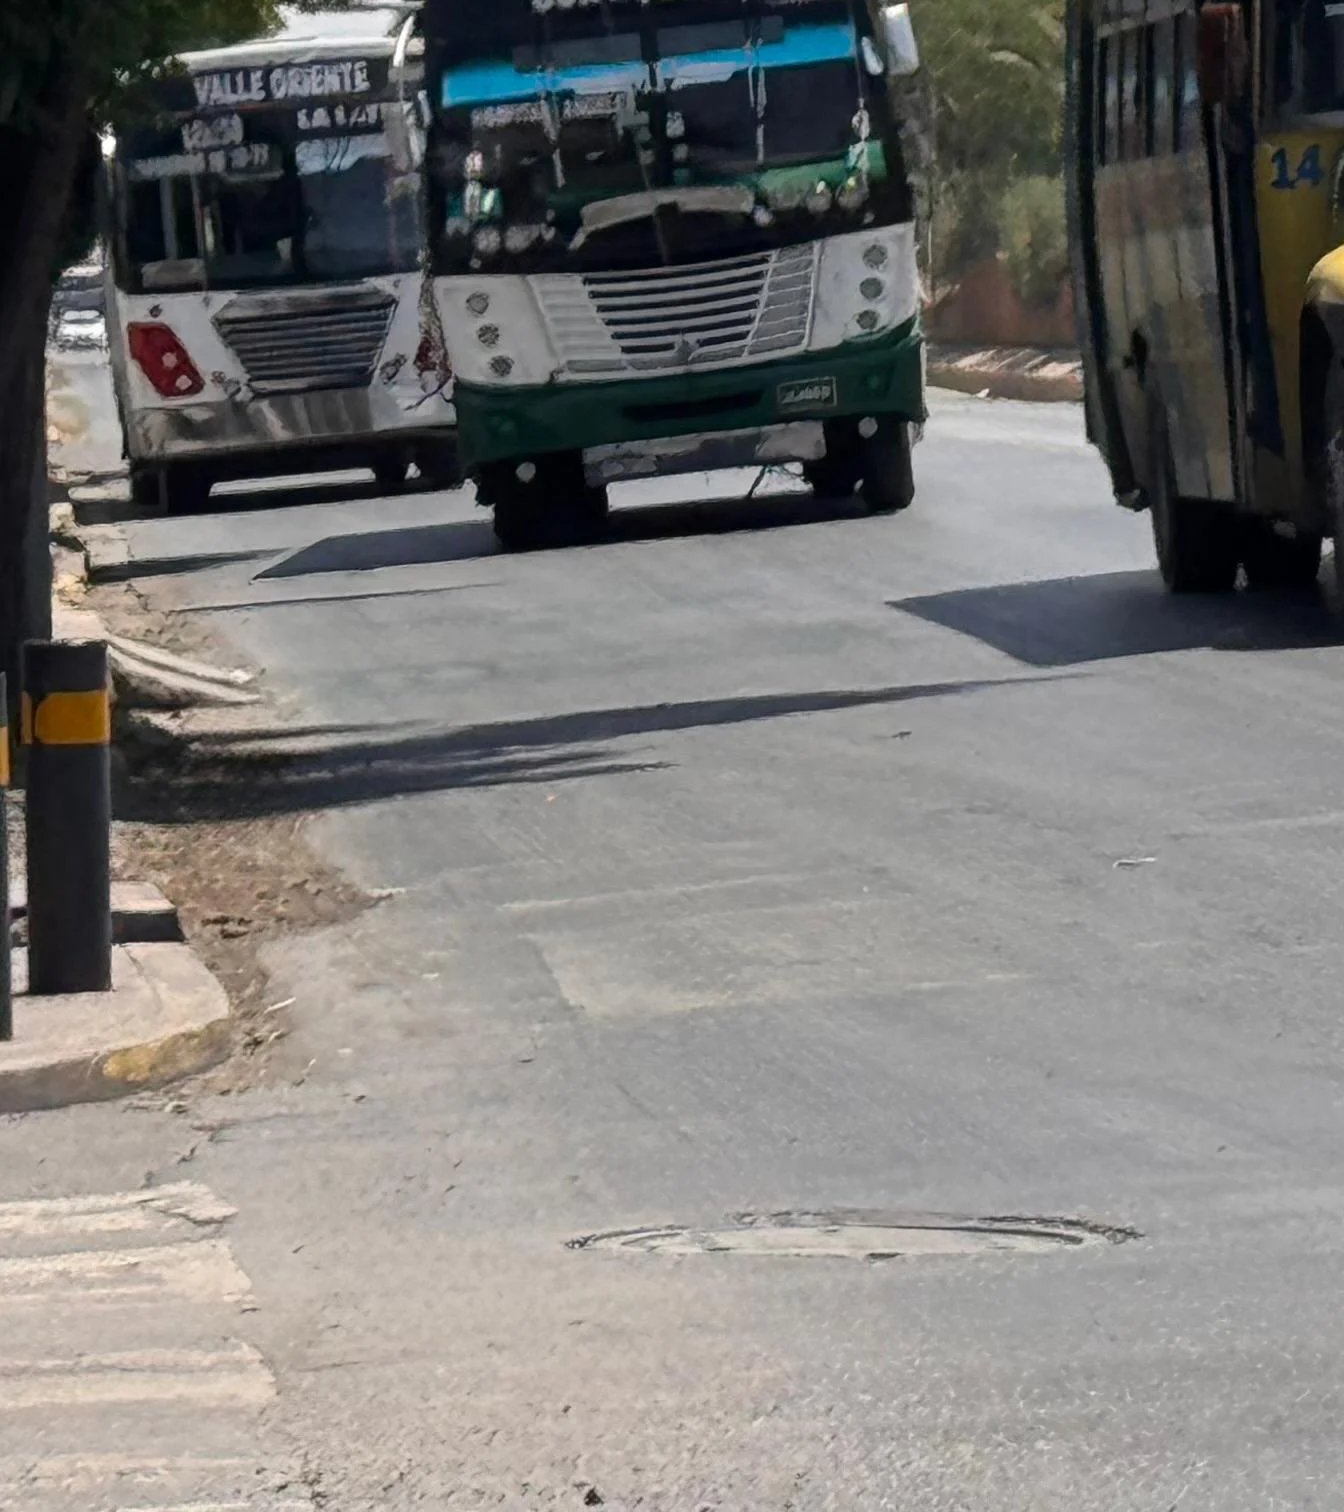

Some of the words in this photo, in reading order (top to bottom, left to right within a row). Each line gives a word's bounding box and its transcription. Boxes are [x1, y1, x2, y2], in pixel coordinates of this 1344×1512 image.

[194, 68, 266, 107] VALLE
[269, 59, 371, 100] ORIENTE
[1270, 143, 1328, 189] 14
